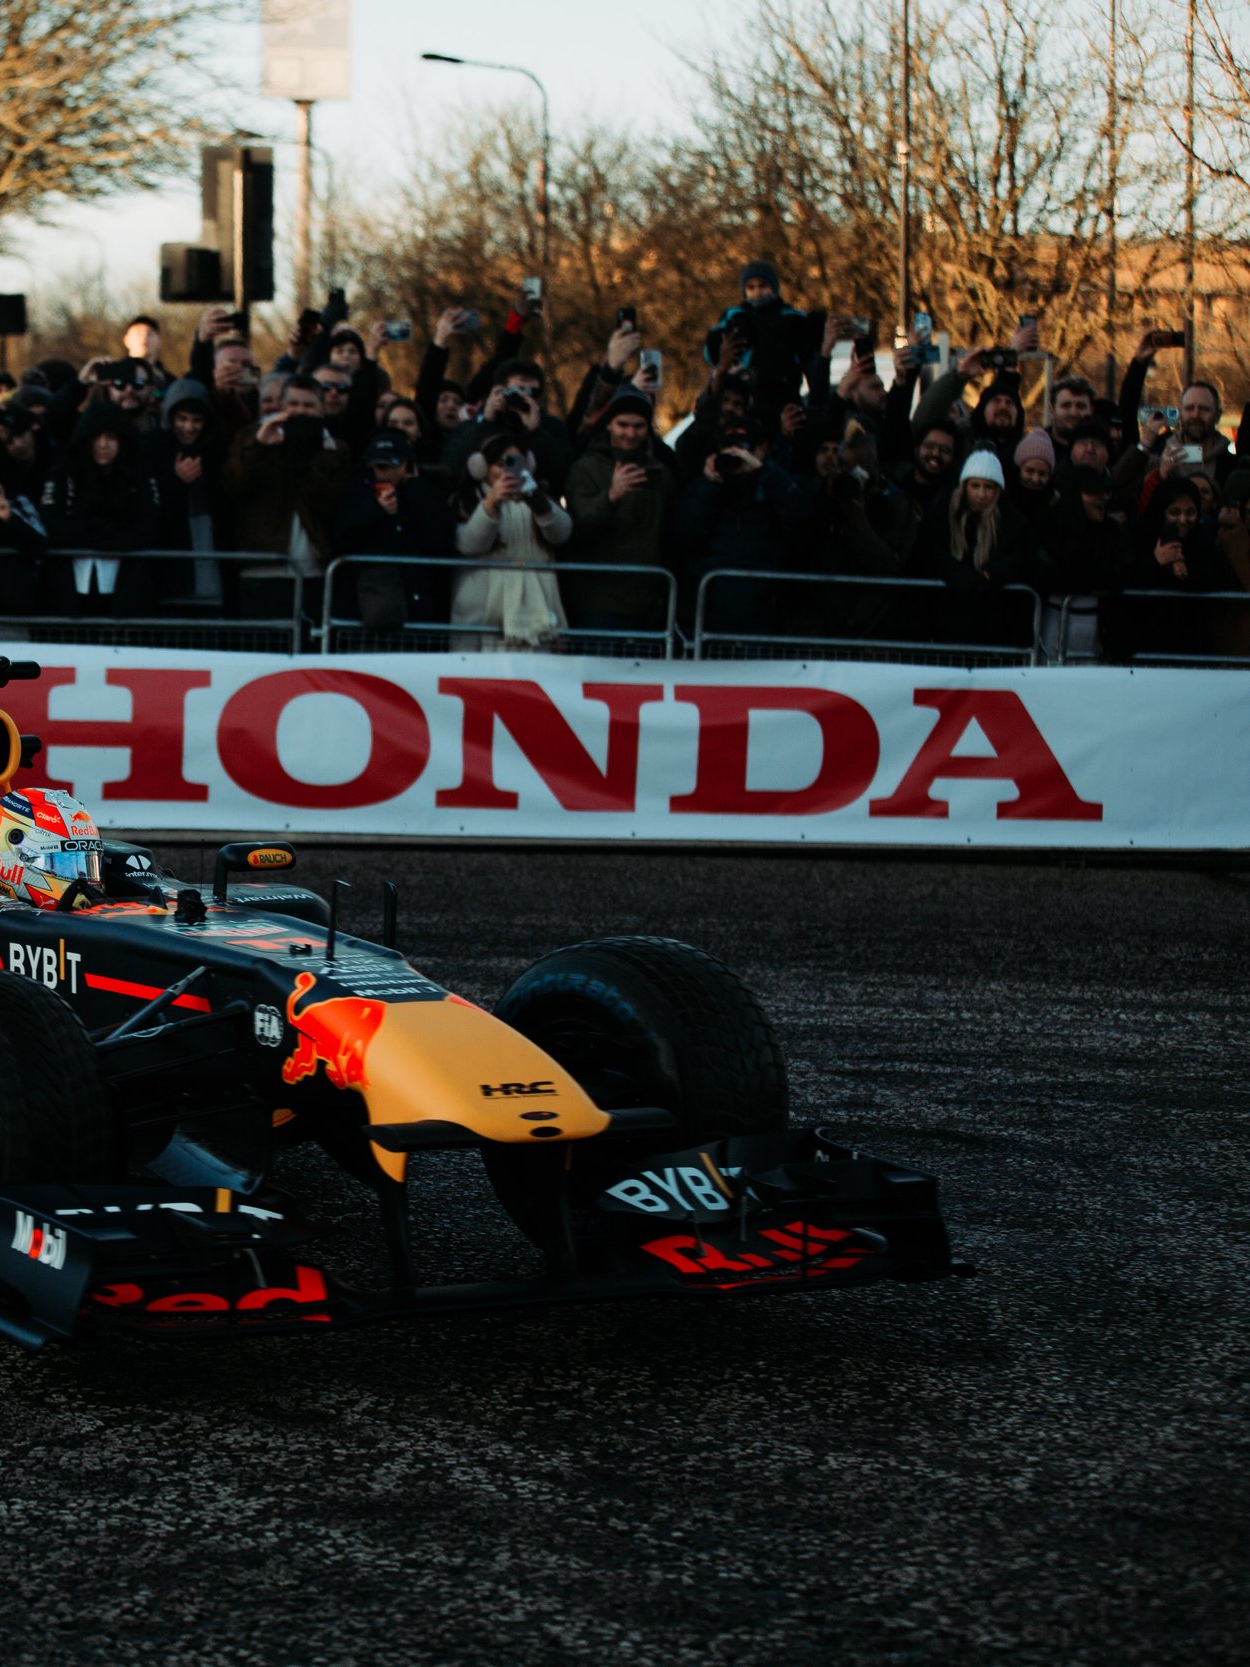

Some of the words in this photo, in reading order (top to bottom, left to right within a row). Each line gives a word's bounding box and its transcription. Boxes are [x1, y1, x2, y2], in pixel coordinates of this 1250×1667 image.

[36, 811, 58, 824] Claro
[64, 841, 102, 852] ORAC
[260, 853, 288, 864] RAUCH
[9, 937, 81, 994] BYBIT
[352, 986, 421, 998] Mobil
[480, 1081, 556, 1097] HRC
